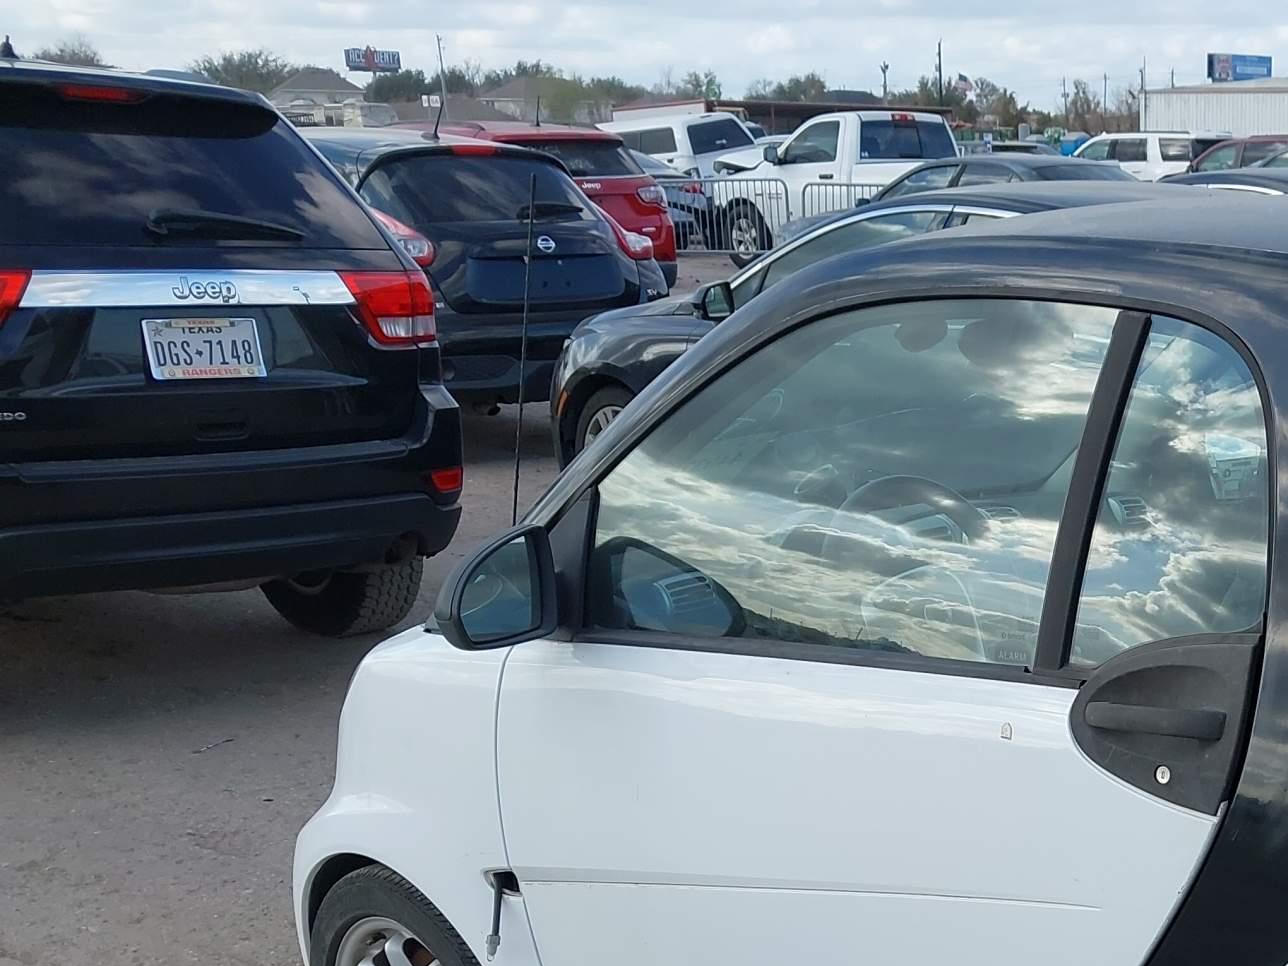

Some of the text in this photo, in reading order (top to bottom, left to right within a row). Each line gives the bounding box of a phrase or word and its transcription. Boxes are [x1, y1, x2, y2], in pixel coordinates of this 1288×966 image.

[349, 48, 399, 64] ACCDENT?
[172, 276, 237, 303] Jeep
[182, 367, 242, 376] RANGERS
